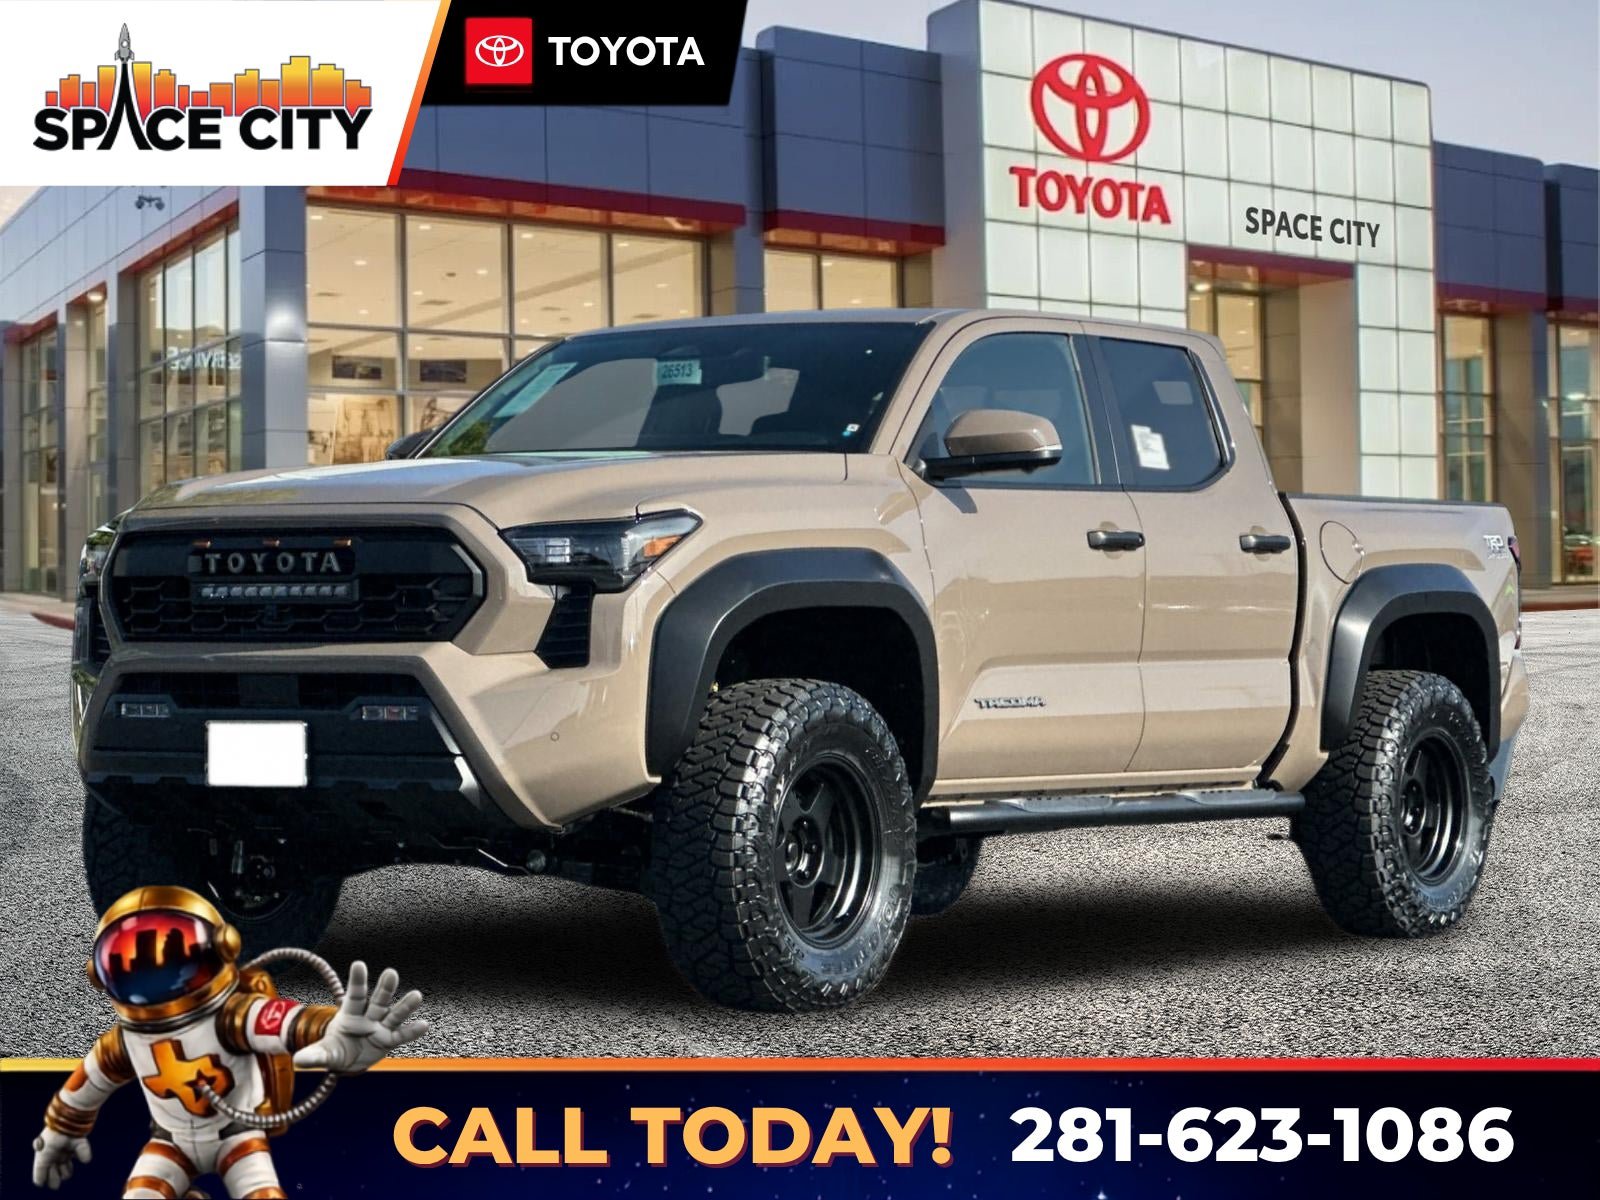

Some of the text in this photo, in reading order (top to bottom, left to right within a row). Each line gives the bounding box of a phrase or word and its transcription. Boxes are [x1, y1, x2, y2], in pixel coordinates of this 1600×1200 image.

[1009, 166, 1172, 224] TOYOTA
[1245, 206, 1381, 248] SPACE CITY
[204, 551, 342, 574] TOYOTA
